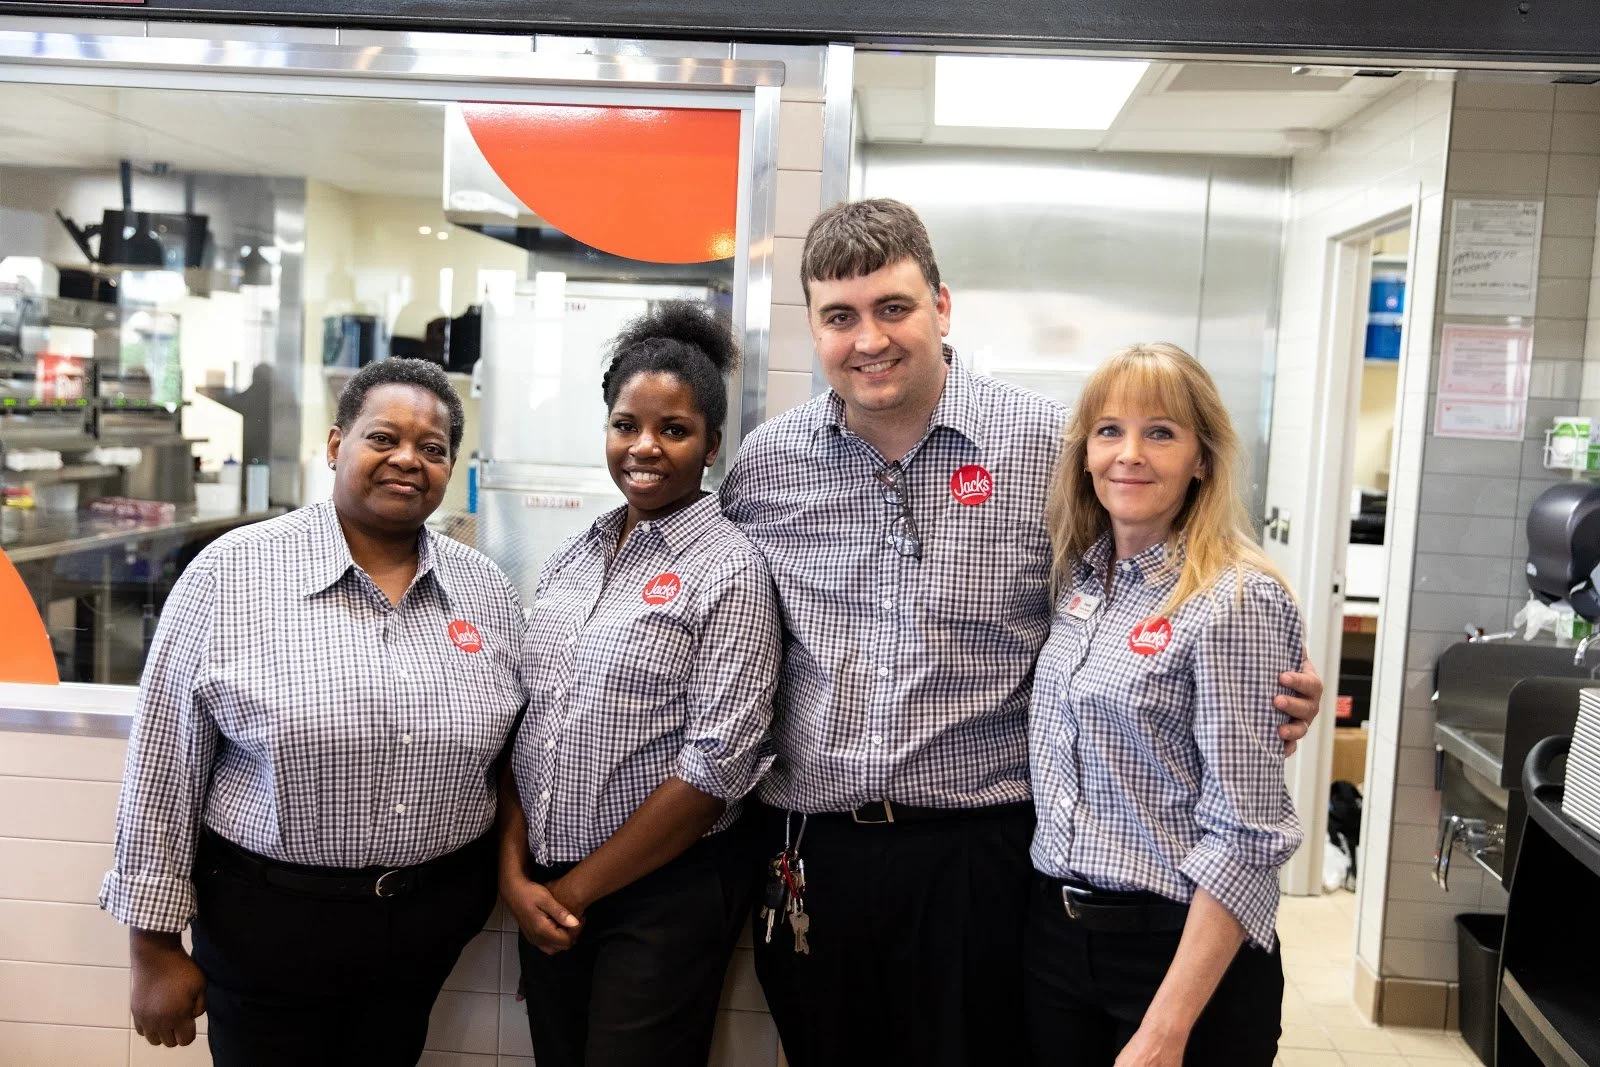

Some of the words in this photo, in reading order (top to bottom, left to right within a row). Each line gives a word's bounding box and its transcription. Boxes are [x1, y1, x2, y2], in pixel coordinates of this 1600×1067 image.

[954, 471, 989, 495] Jack's
[645, 577, 678, 597] Jack's
[452, 625, 480, 645] Jack's
[1131, 622, 1167, 648] Jack's
